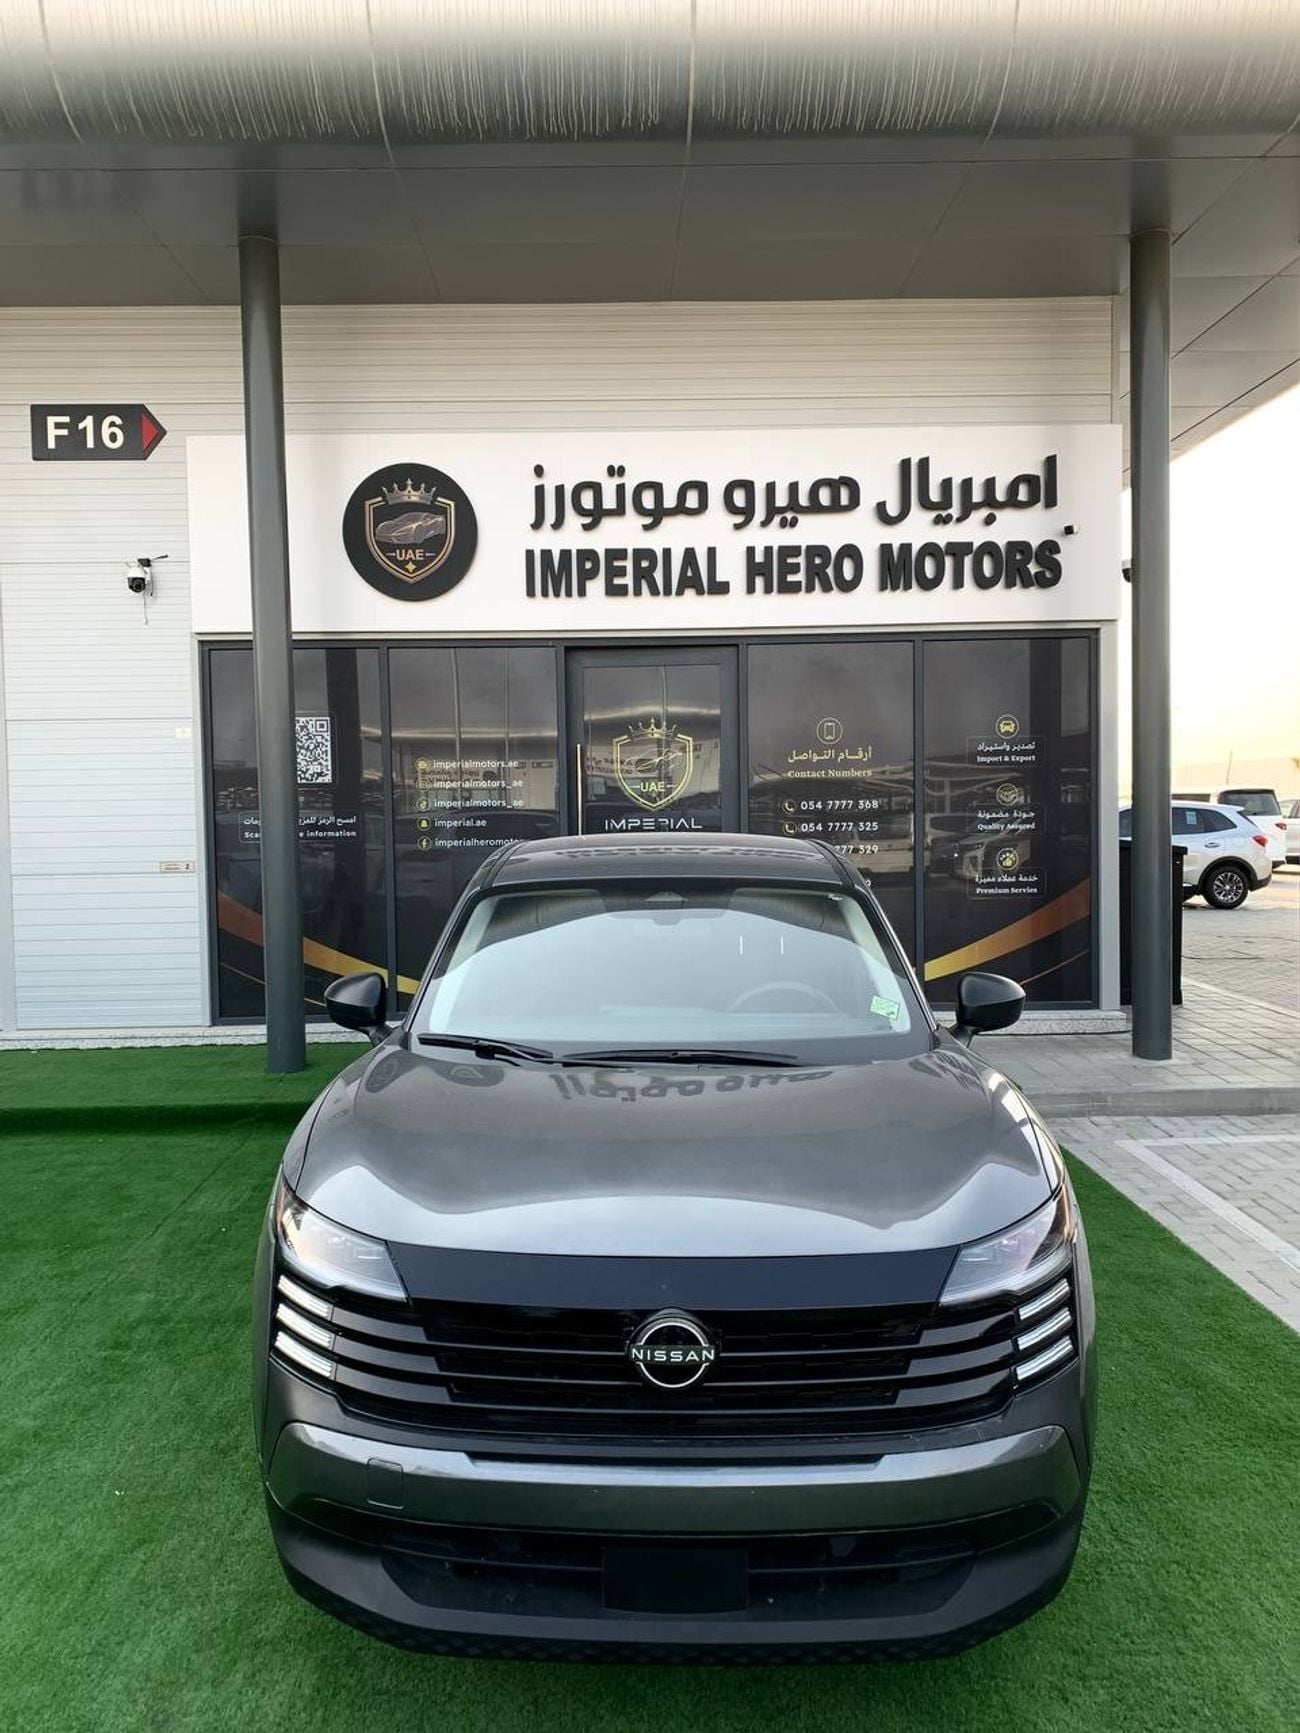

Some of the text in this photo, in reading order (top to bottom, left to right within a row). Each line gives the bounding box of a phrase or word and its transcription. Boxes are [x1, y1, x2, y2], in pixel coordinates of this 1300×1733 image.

[530, 454, 1057, 531] امبريال هيرو موتورز
[396, 549, 425, 560] UAE
[525, 539, 1062, 597] IMPERIAL HERO MOTORS
[977, 755, 1002, 763] Import
[1011, 755, 1035, 763] Export
[433, 760, 519, 769] imperialmotors.ae
[788, 768, 872, 778] Contact Numbers
[640, 782, 666, 792] UAE
[800, 800, 878, 810] 054 7777 368
[434, 819, 488, 828] imperial.ae
[605, 818, 703, 830] IMPERIAL
[801, 822, 878, 832] 054 7777 325
[859, 845, 879, 854] 329
[632, 1348, 714, 1362] NISSAN
